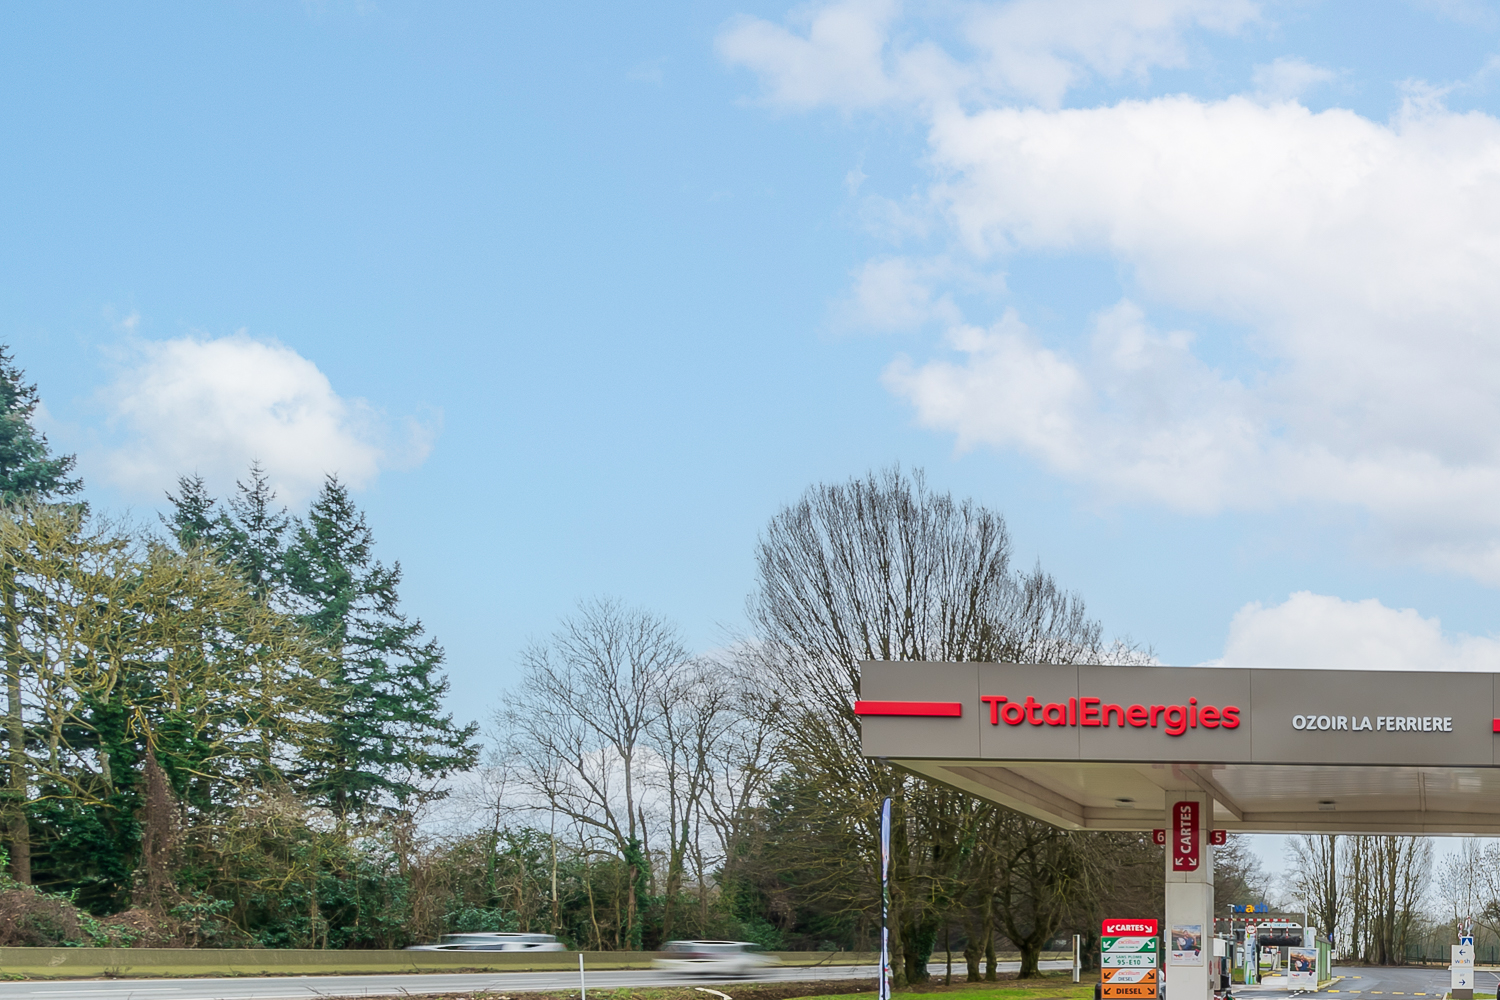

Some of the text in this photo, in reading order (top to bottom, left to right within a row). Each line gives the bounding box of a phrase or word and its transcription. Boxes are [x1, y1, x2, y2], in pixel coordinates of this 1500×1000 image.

[981, 694, 1241, 737] TotalEnergies
[1292, 714, 1453, 732] OZOIR LA FERRIERE
[1180, 805, 1191, 854] CARTES
[1157, 832, 1164, 842] 6
[1215, 832, 1222, 843] 5
[1234, 902, 1269, 914] wash
[1115, 924, 1145, 932] CARTES
